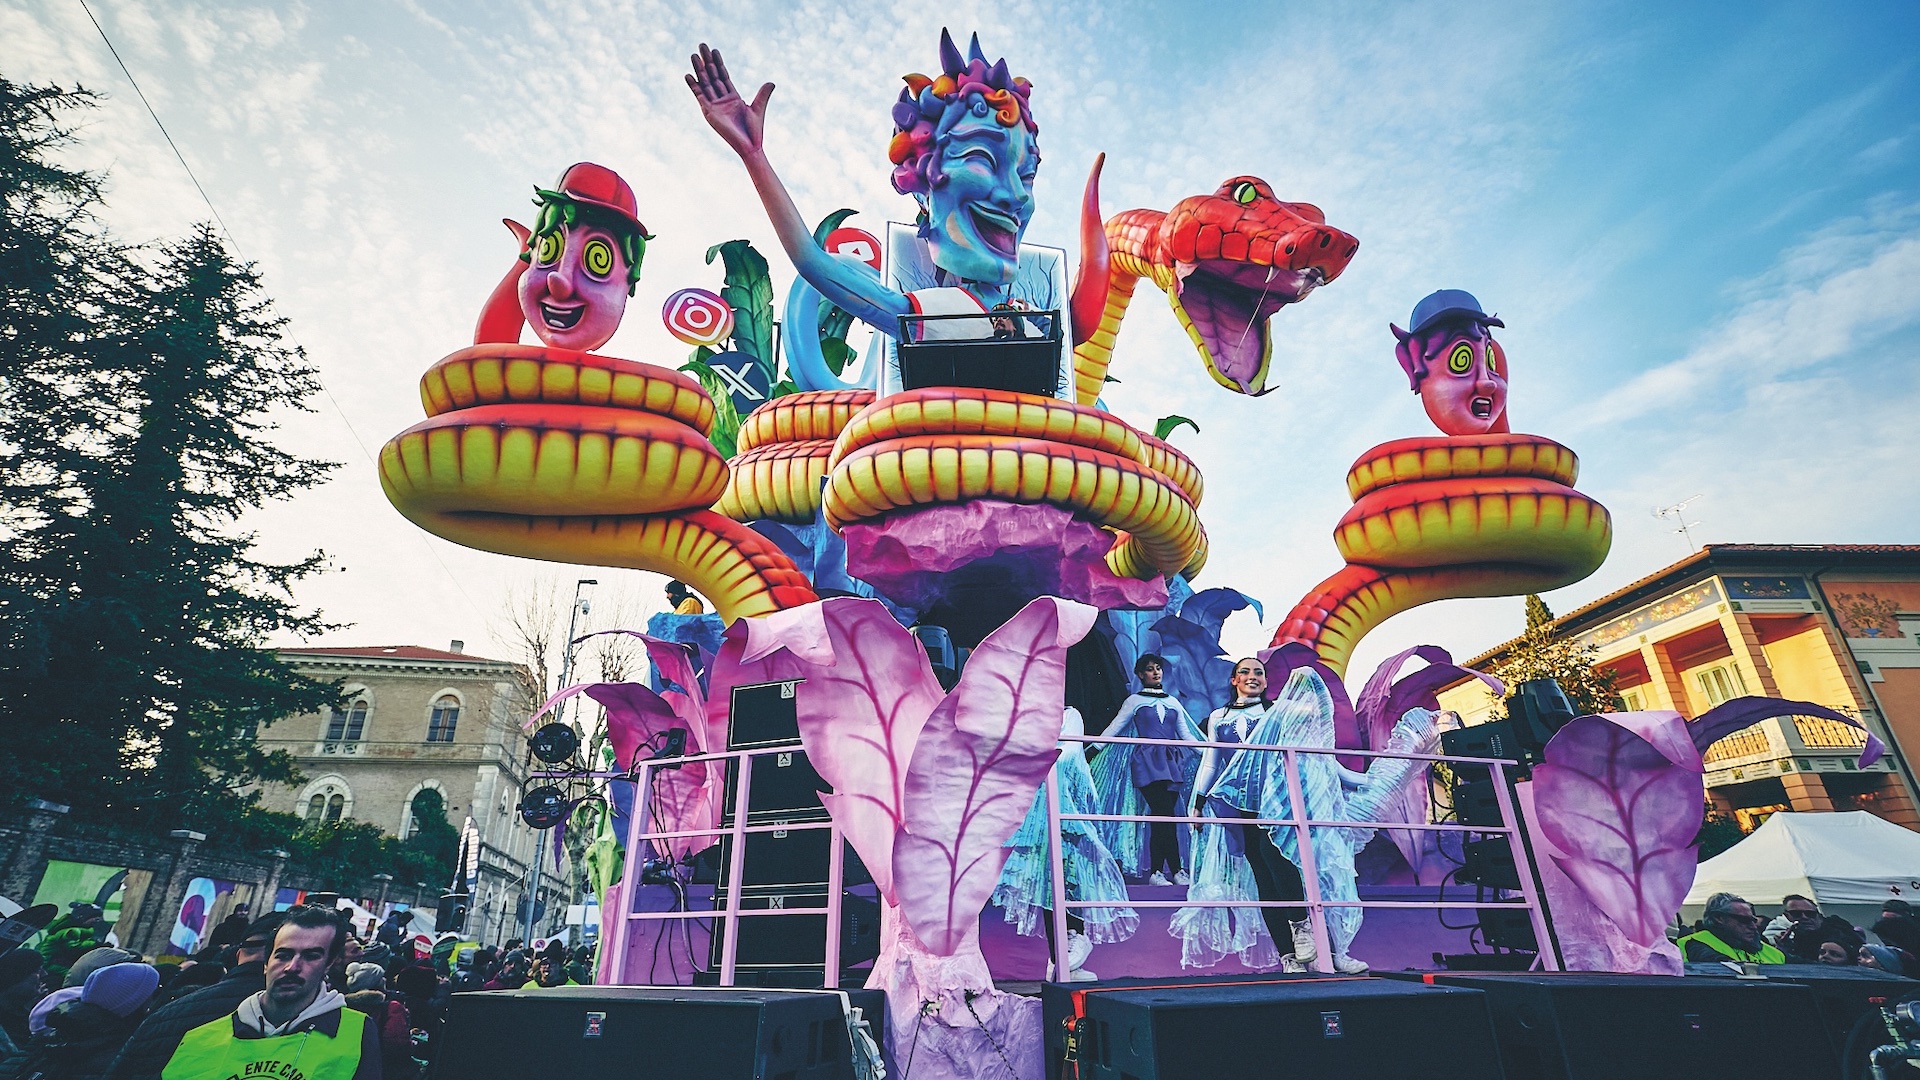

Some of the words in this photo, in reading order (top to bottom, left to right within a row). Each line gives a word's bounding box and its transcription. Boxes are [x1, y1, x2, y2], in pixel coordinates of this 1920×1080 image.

[1911, 881, 1920, 890] C
[245, 1060, 281, 1075] ENTE
[279, 1064, 305, 1080] CAR
